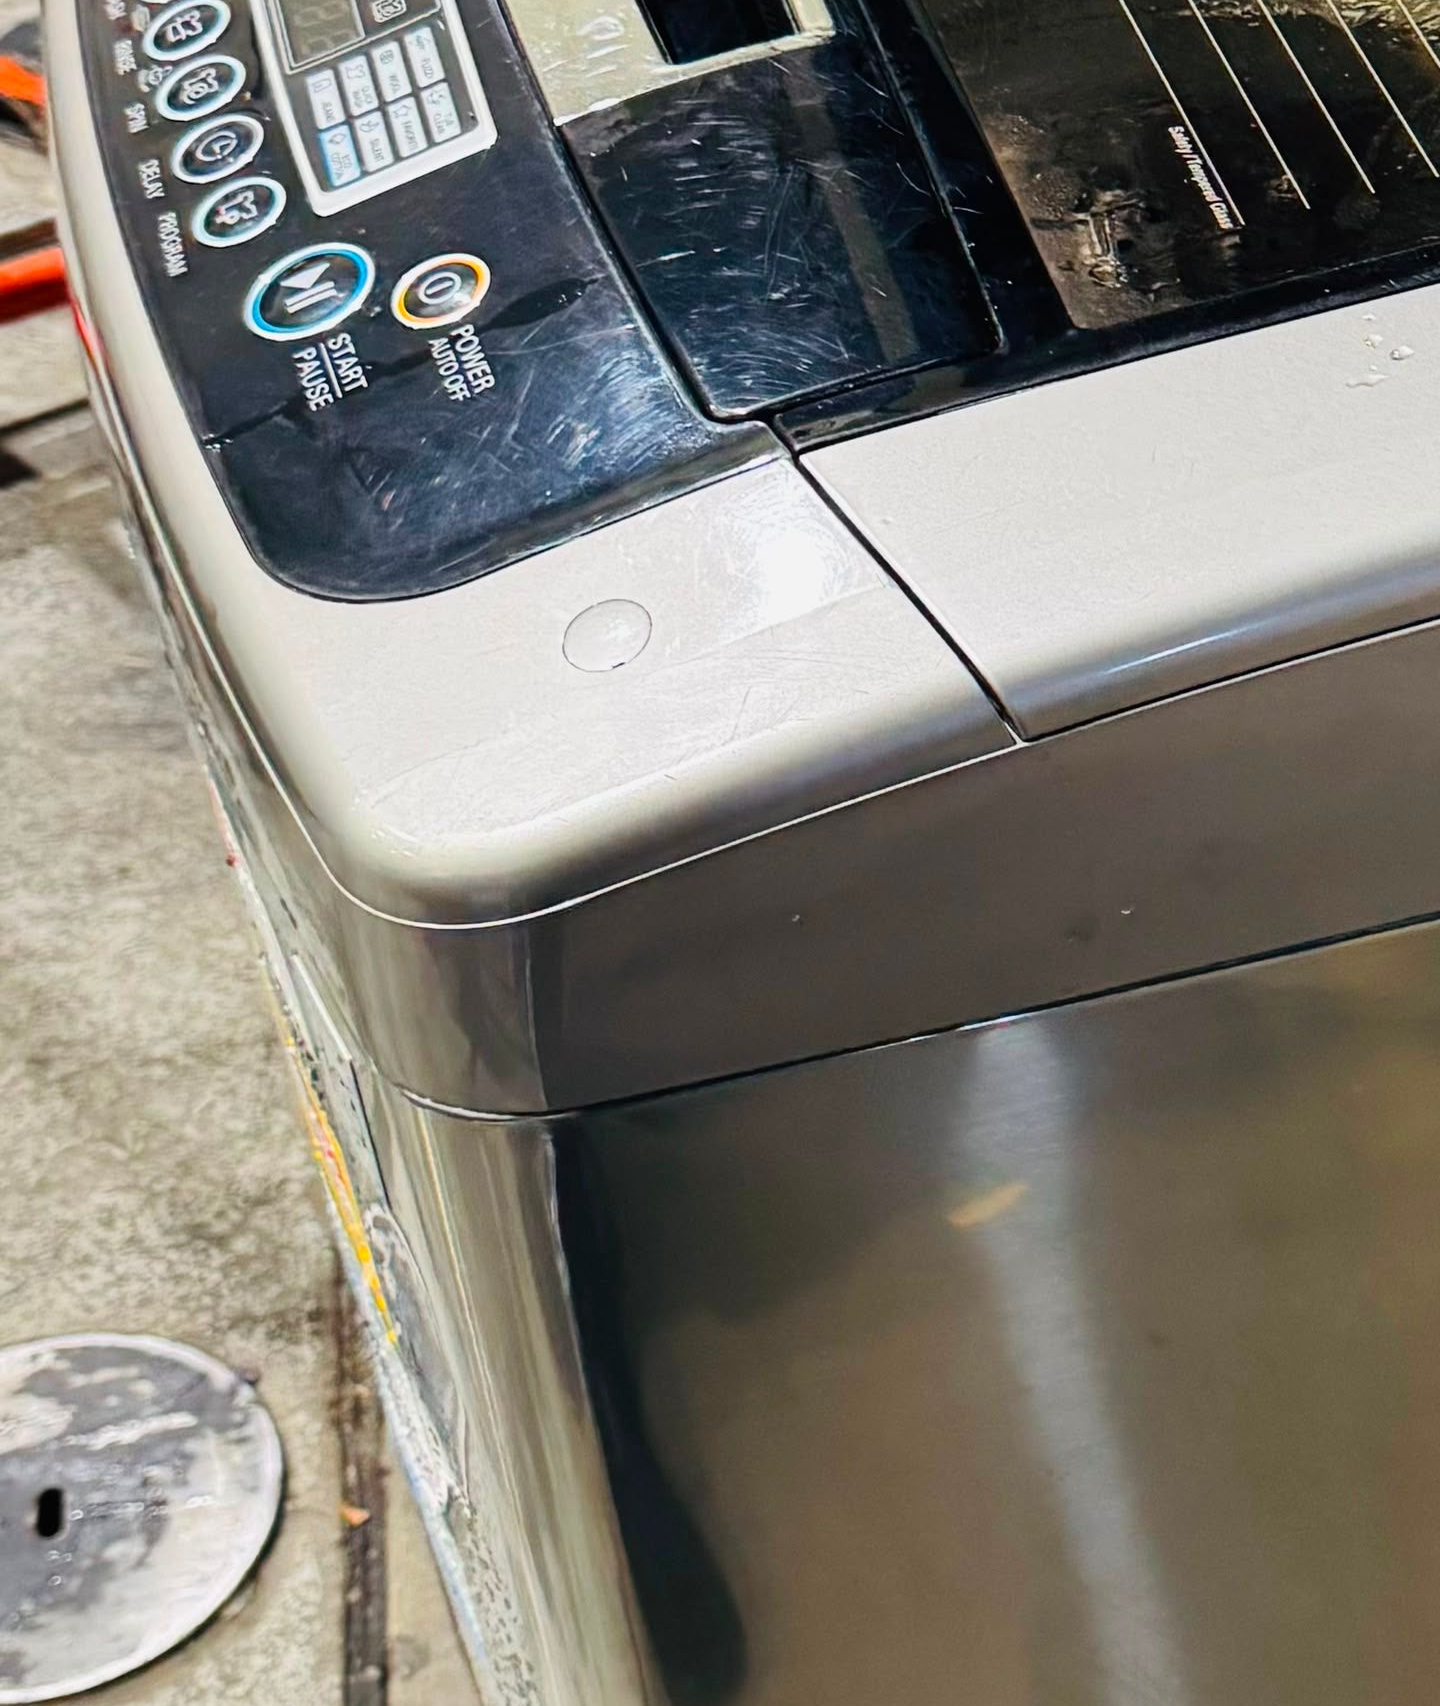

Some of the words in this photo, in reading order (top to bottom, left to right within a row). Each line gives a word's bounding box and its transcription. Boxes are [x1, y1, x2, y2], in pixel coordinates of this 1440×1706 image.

[124, 102, 148, 133] SPIN
[137, 158, 165, 199] DELAY
[158, 212, 188, 278] PROGRAM
[293, 346, 334, 412] PAUSE
[327, 332, 368, 392] START
[428, 337, 459, 376] AUTO
[444, 375, 472, 402] OFF
[452, 324, 496, 394] POWER
